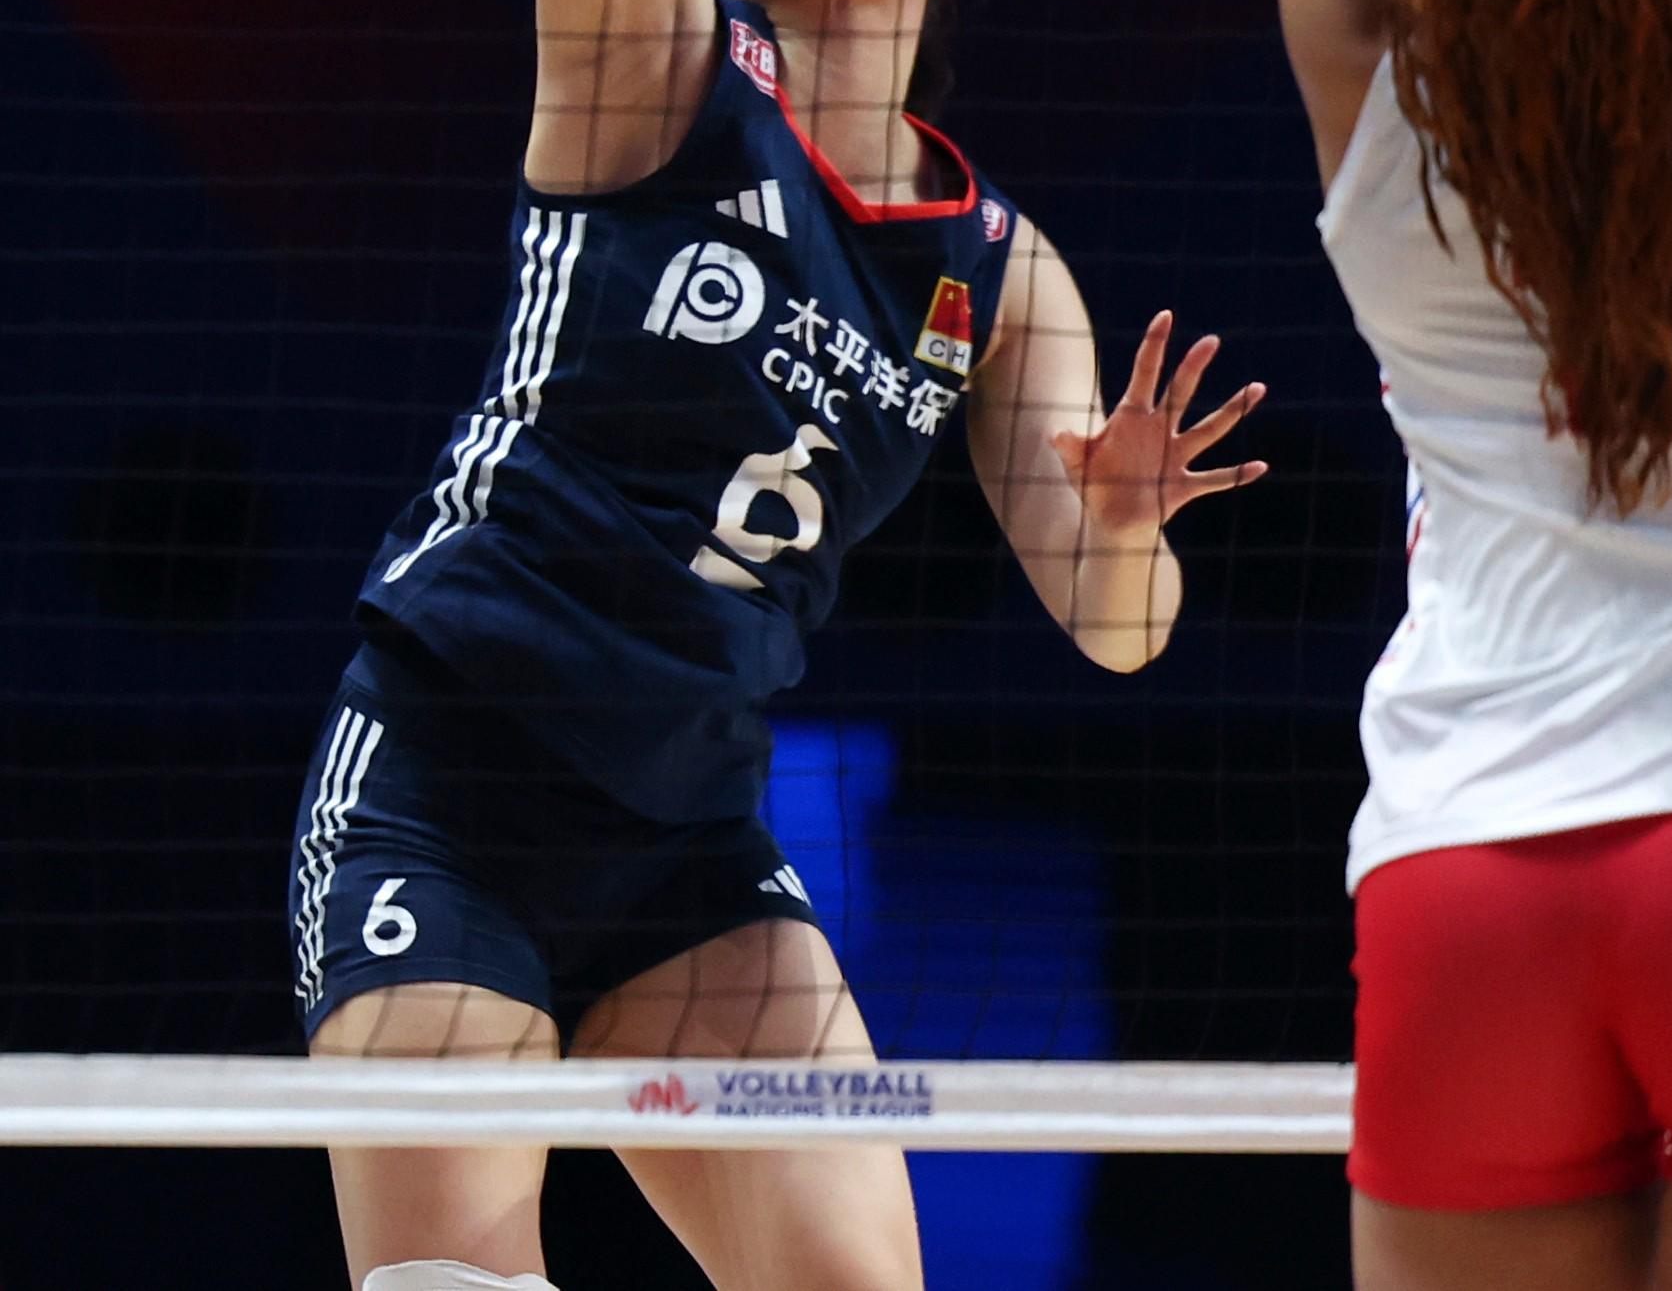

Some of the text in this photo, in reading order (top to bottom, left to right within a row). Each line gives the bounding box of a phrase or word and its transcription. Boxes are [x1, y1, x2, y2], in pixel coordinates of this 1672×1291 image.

[761, 347, 850, 425] CPIC
[773, 296, 960, 437] 太平洋保
[688, 423, 840, 590] 6
[361, 877, 418, 957] 6
[716, 1072, 932, 1097] VOLLEYBALL
